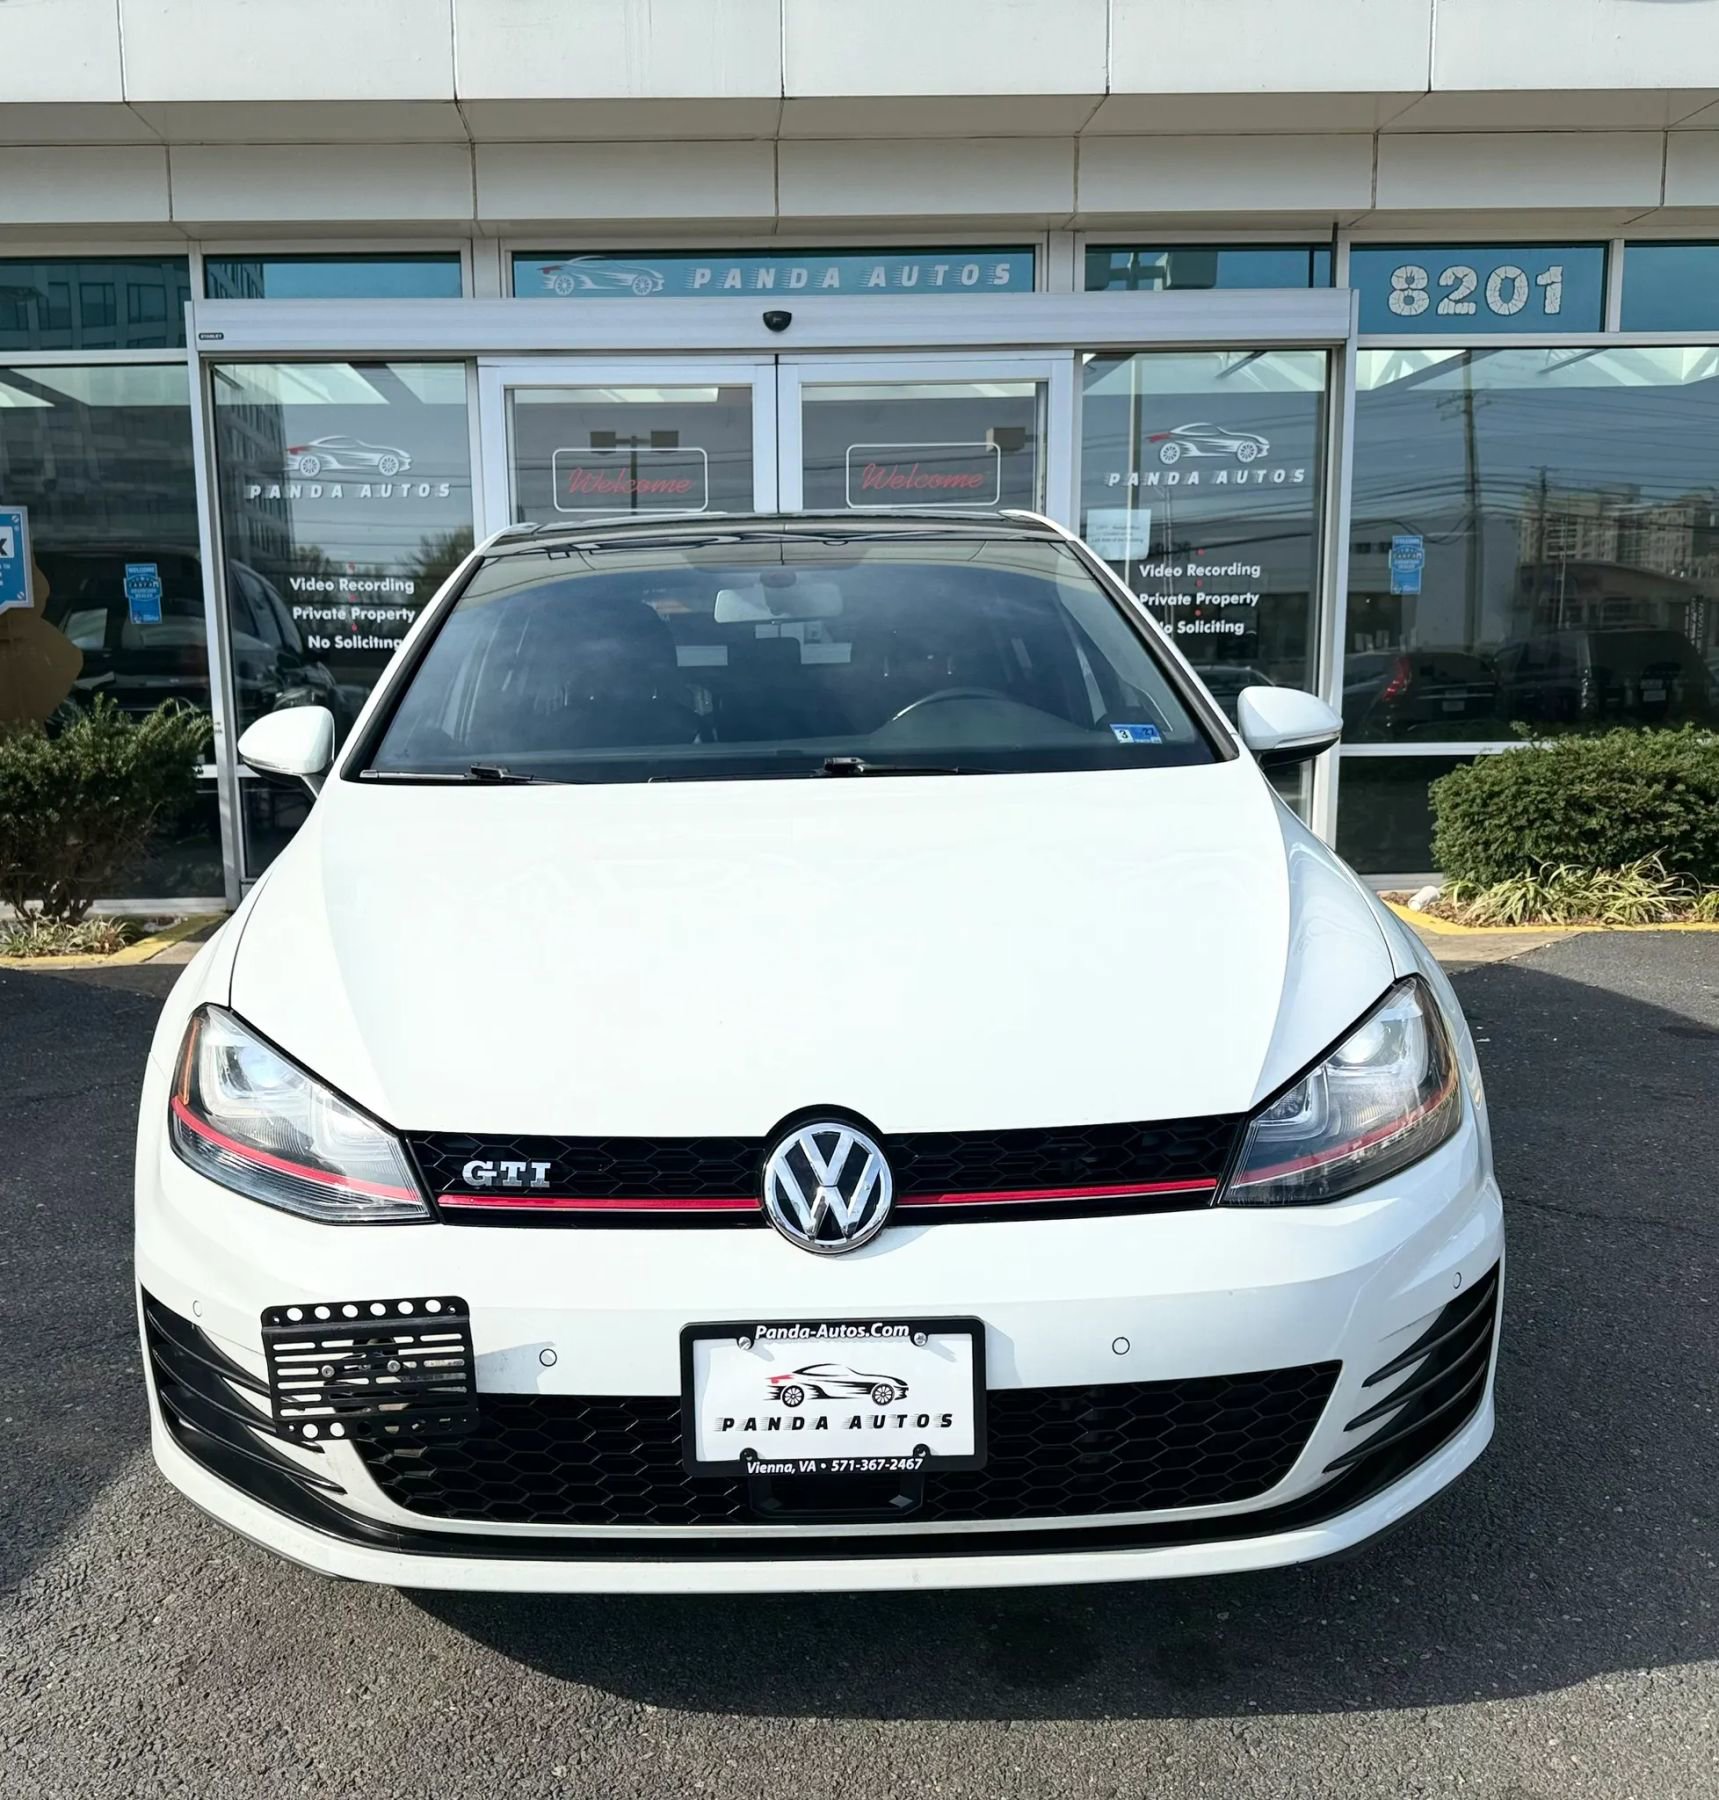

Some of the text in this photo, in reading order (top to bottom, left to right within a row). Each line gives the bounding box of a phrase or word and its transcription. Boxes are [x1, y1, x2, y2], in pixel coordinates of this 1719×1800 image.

[689, 263, 1011, 289] PANDA AUTOS
[1387, 264, 1564, 317] 8201
[568, 466, 693, 495] Welcome
[862, 462, 985, 490] Welcome
[1105, 468, 1305, 487] PANDA AUTOS
[246, 482, 451, 500] PANDA AUTOS
[1139, 562, 1262, 579] Video Recording
[289, 577, 415, 595] Video Recording
[1139, 592, 1260, 608] Private Property
[292, 606, 416, 623] Private Property
[1177, 619, 1245, 636] Soliciting
[307, 635, 331, 649] No
[1119, 729, 1129, 739] 3
[461, 1160, 552, 1189] GTI
[754, 1321, 910, 1341] Panda-Autos.Com
[717, 1413, 954, 1433] PANDA AUTOS
[746, 1457, 924, 1475] Vienna, VA 571-367-2467
